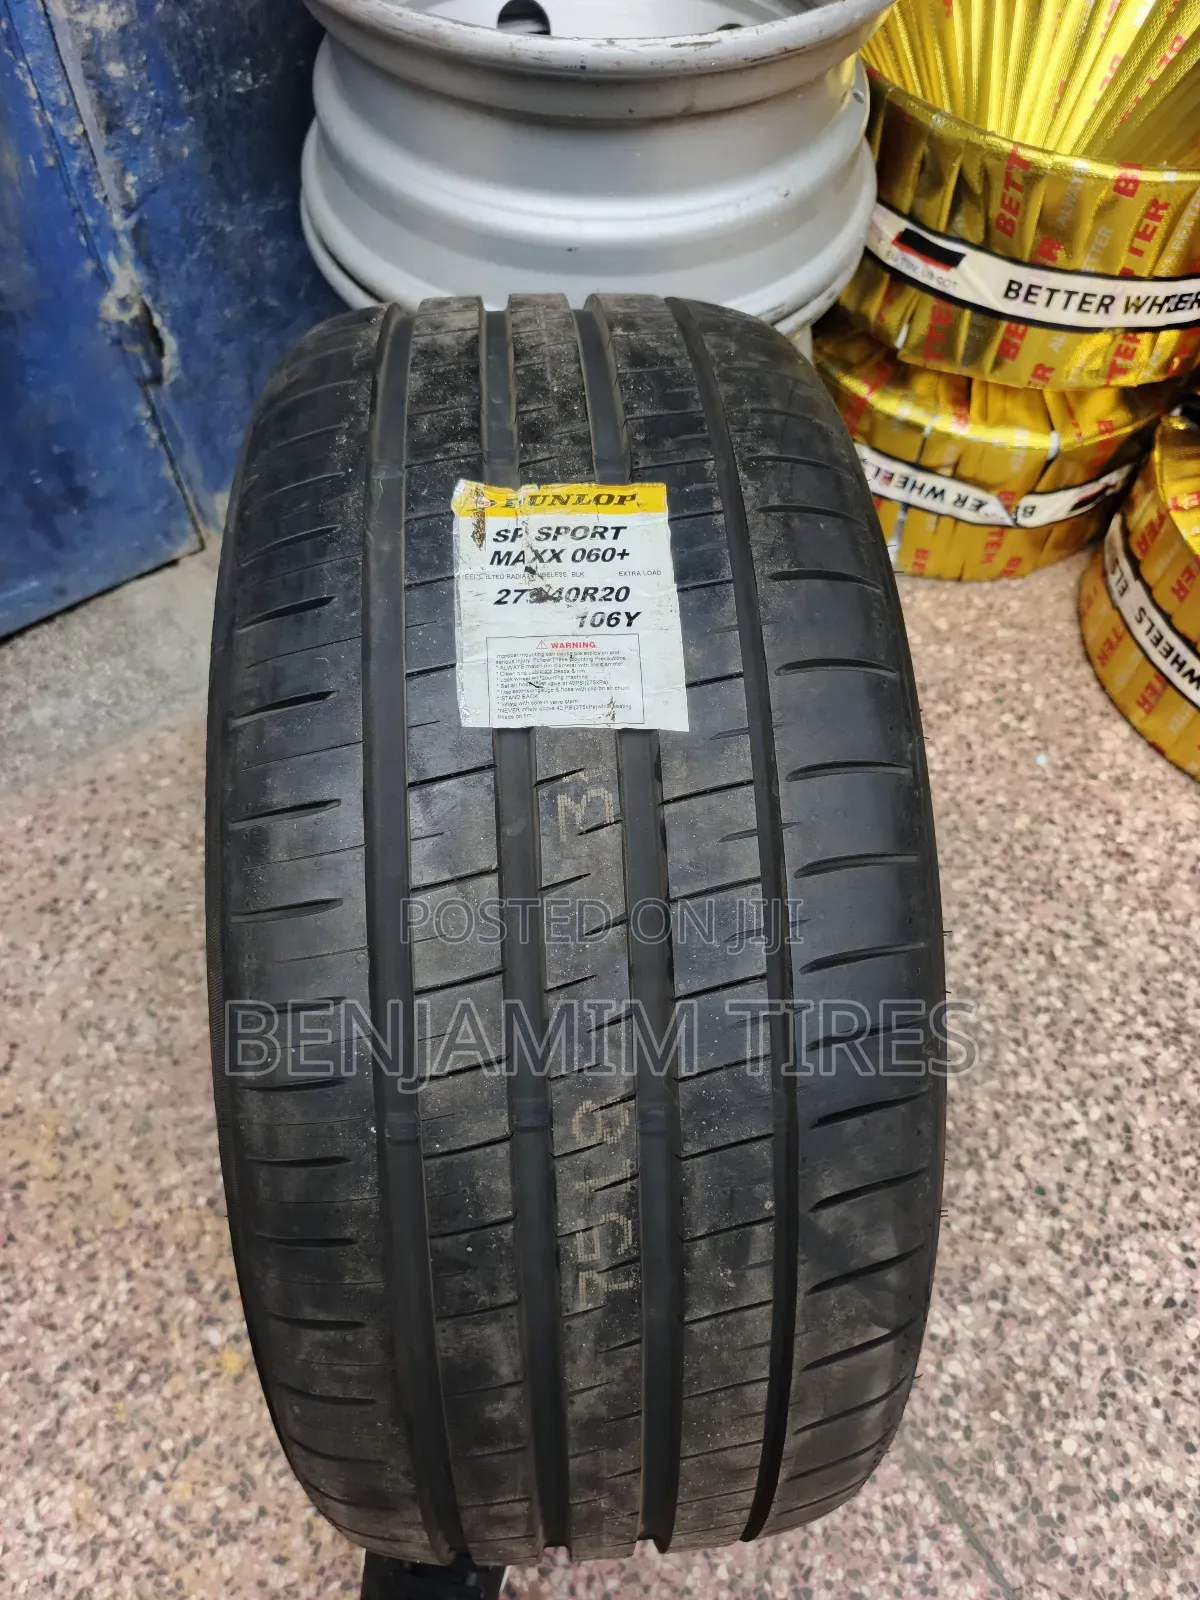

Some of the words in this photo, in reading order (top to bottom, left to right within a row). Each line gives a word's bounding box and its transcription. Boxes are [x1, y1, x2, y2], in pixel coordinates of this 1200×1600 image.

[1003, 279, 1116, 315] BETTER
[873, 467, 946, 502] WHEEL
[493, 527, 524, 543] SP
[535, 525, 628, 542] SPORT
[489, 548, 566, 567] MAXX
[571, 547, 631, 564] 060+
[577, 611, 642, 628] 106Y
